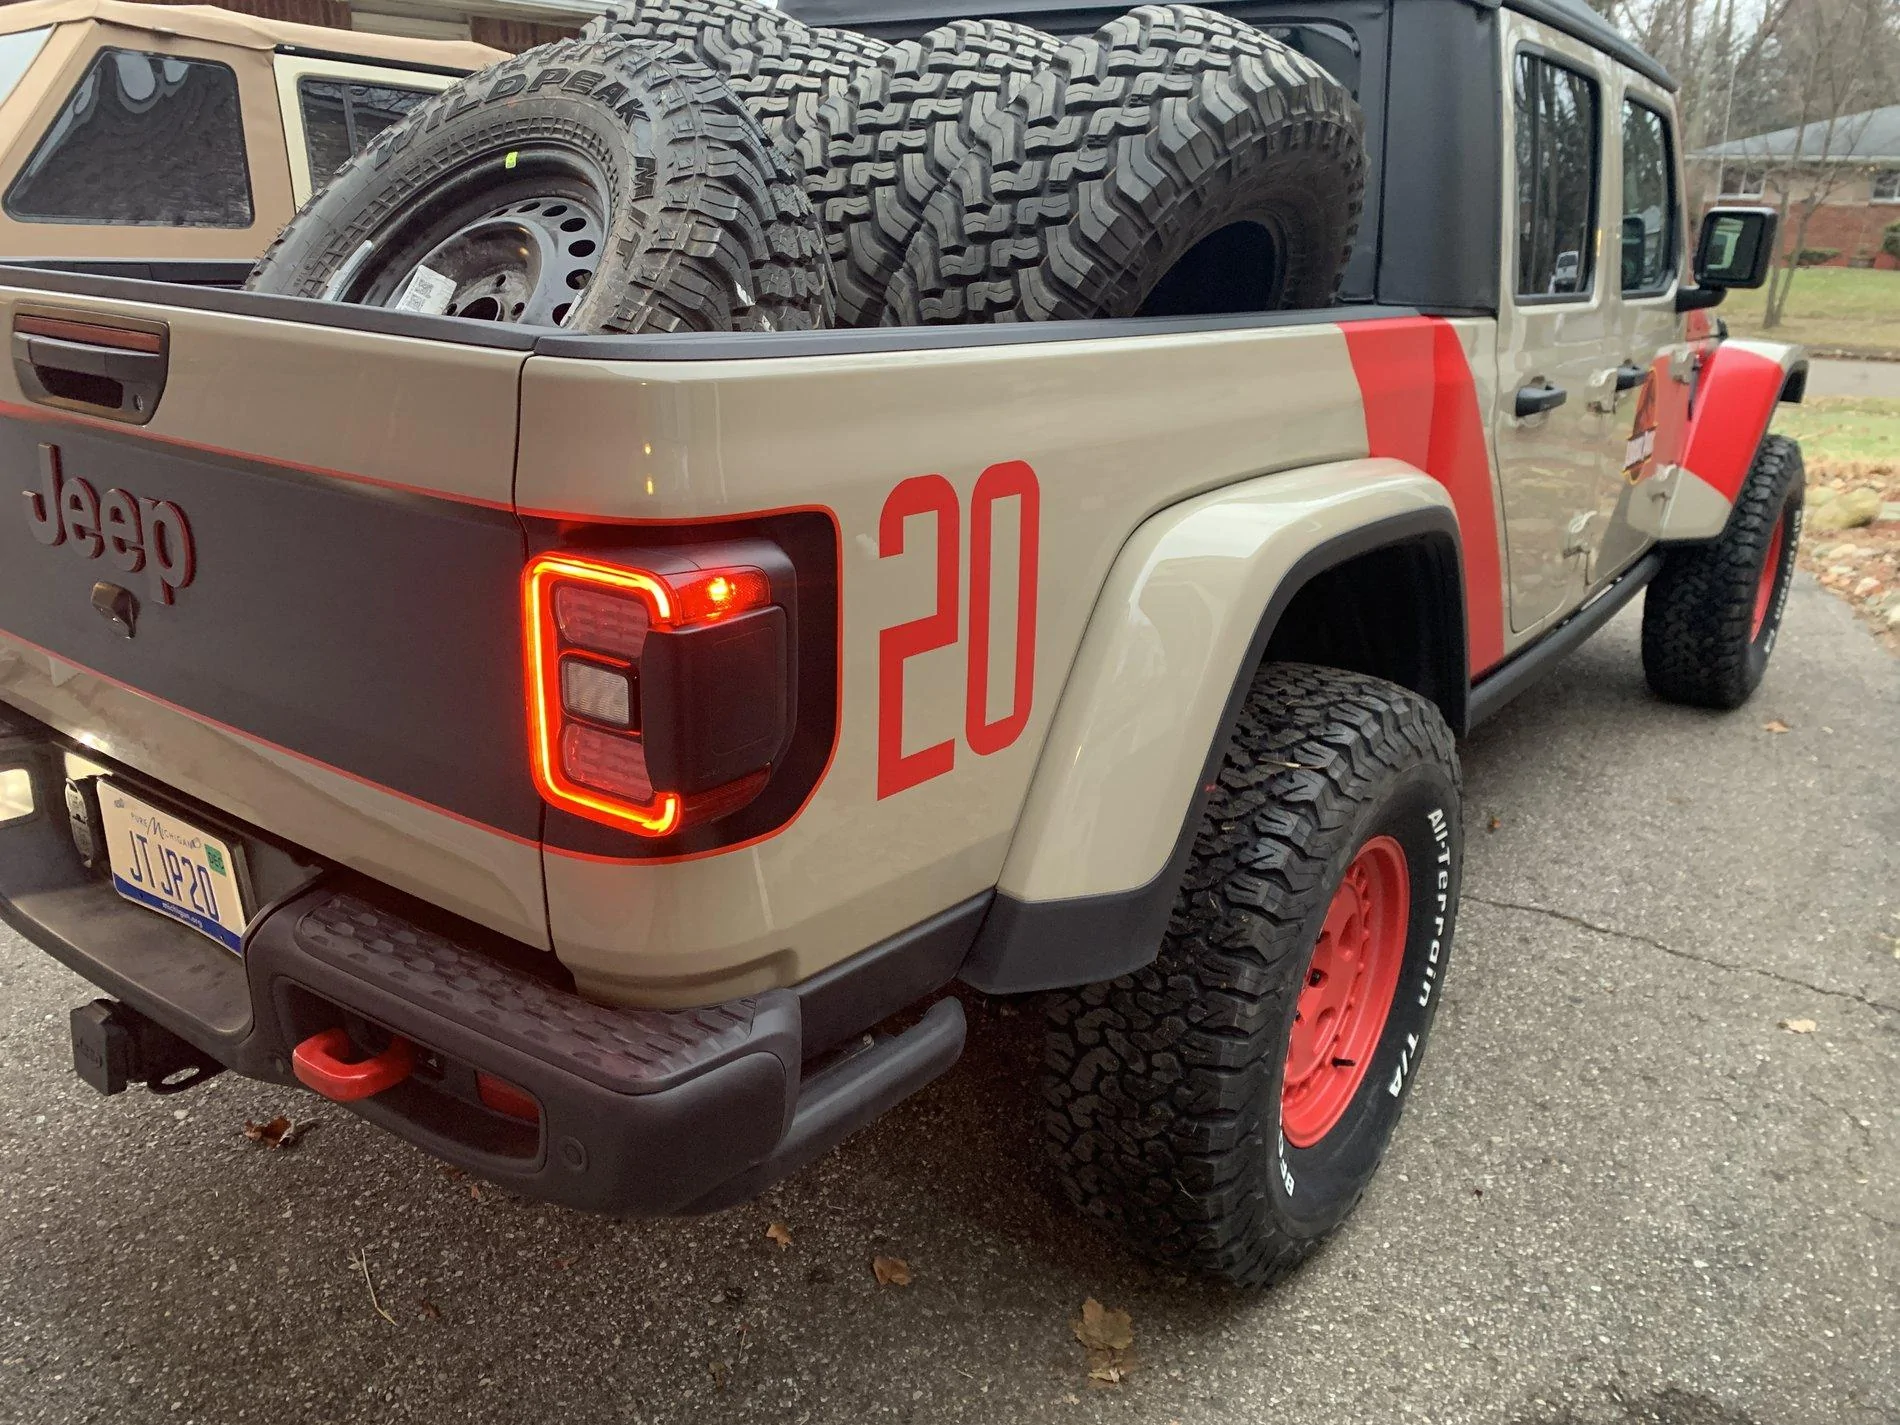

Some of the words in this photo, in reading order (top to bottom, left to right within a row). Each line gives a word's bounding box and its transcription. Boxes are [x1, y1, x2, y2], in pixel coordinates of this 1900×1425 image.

[374, 67, 652, 172] WILDPEAK
[22, 442, 197, 606] Jeep
[877, 459, 1040, 802] 20
[1418, 808, 1451, 1008] All-Terrain
[1388, 1032, 1420, 1098] T/A
